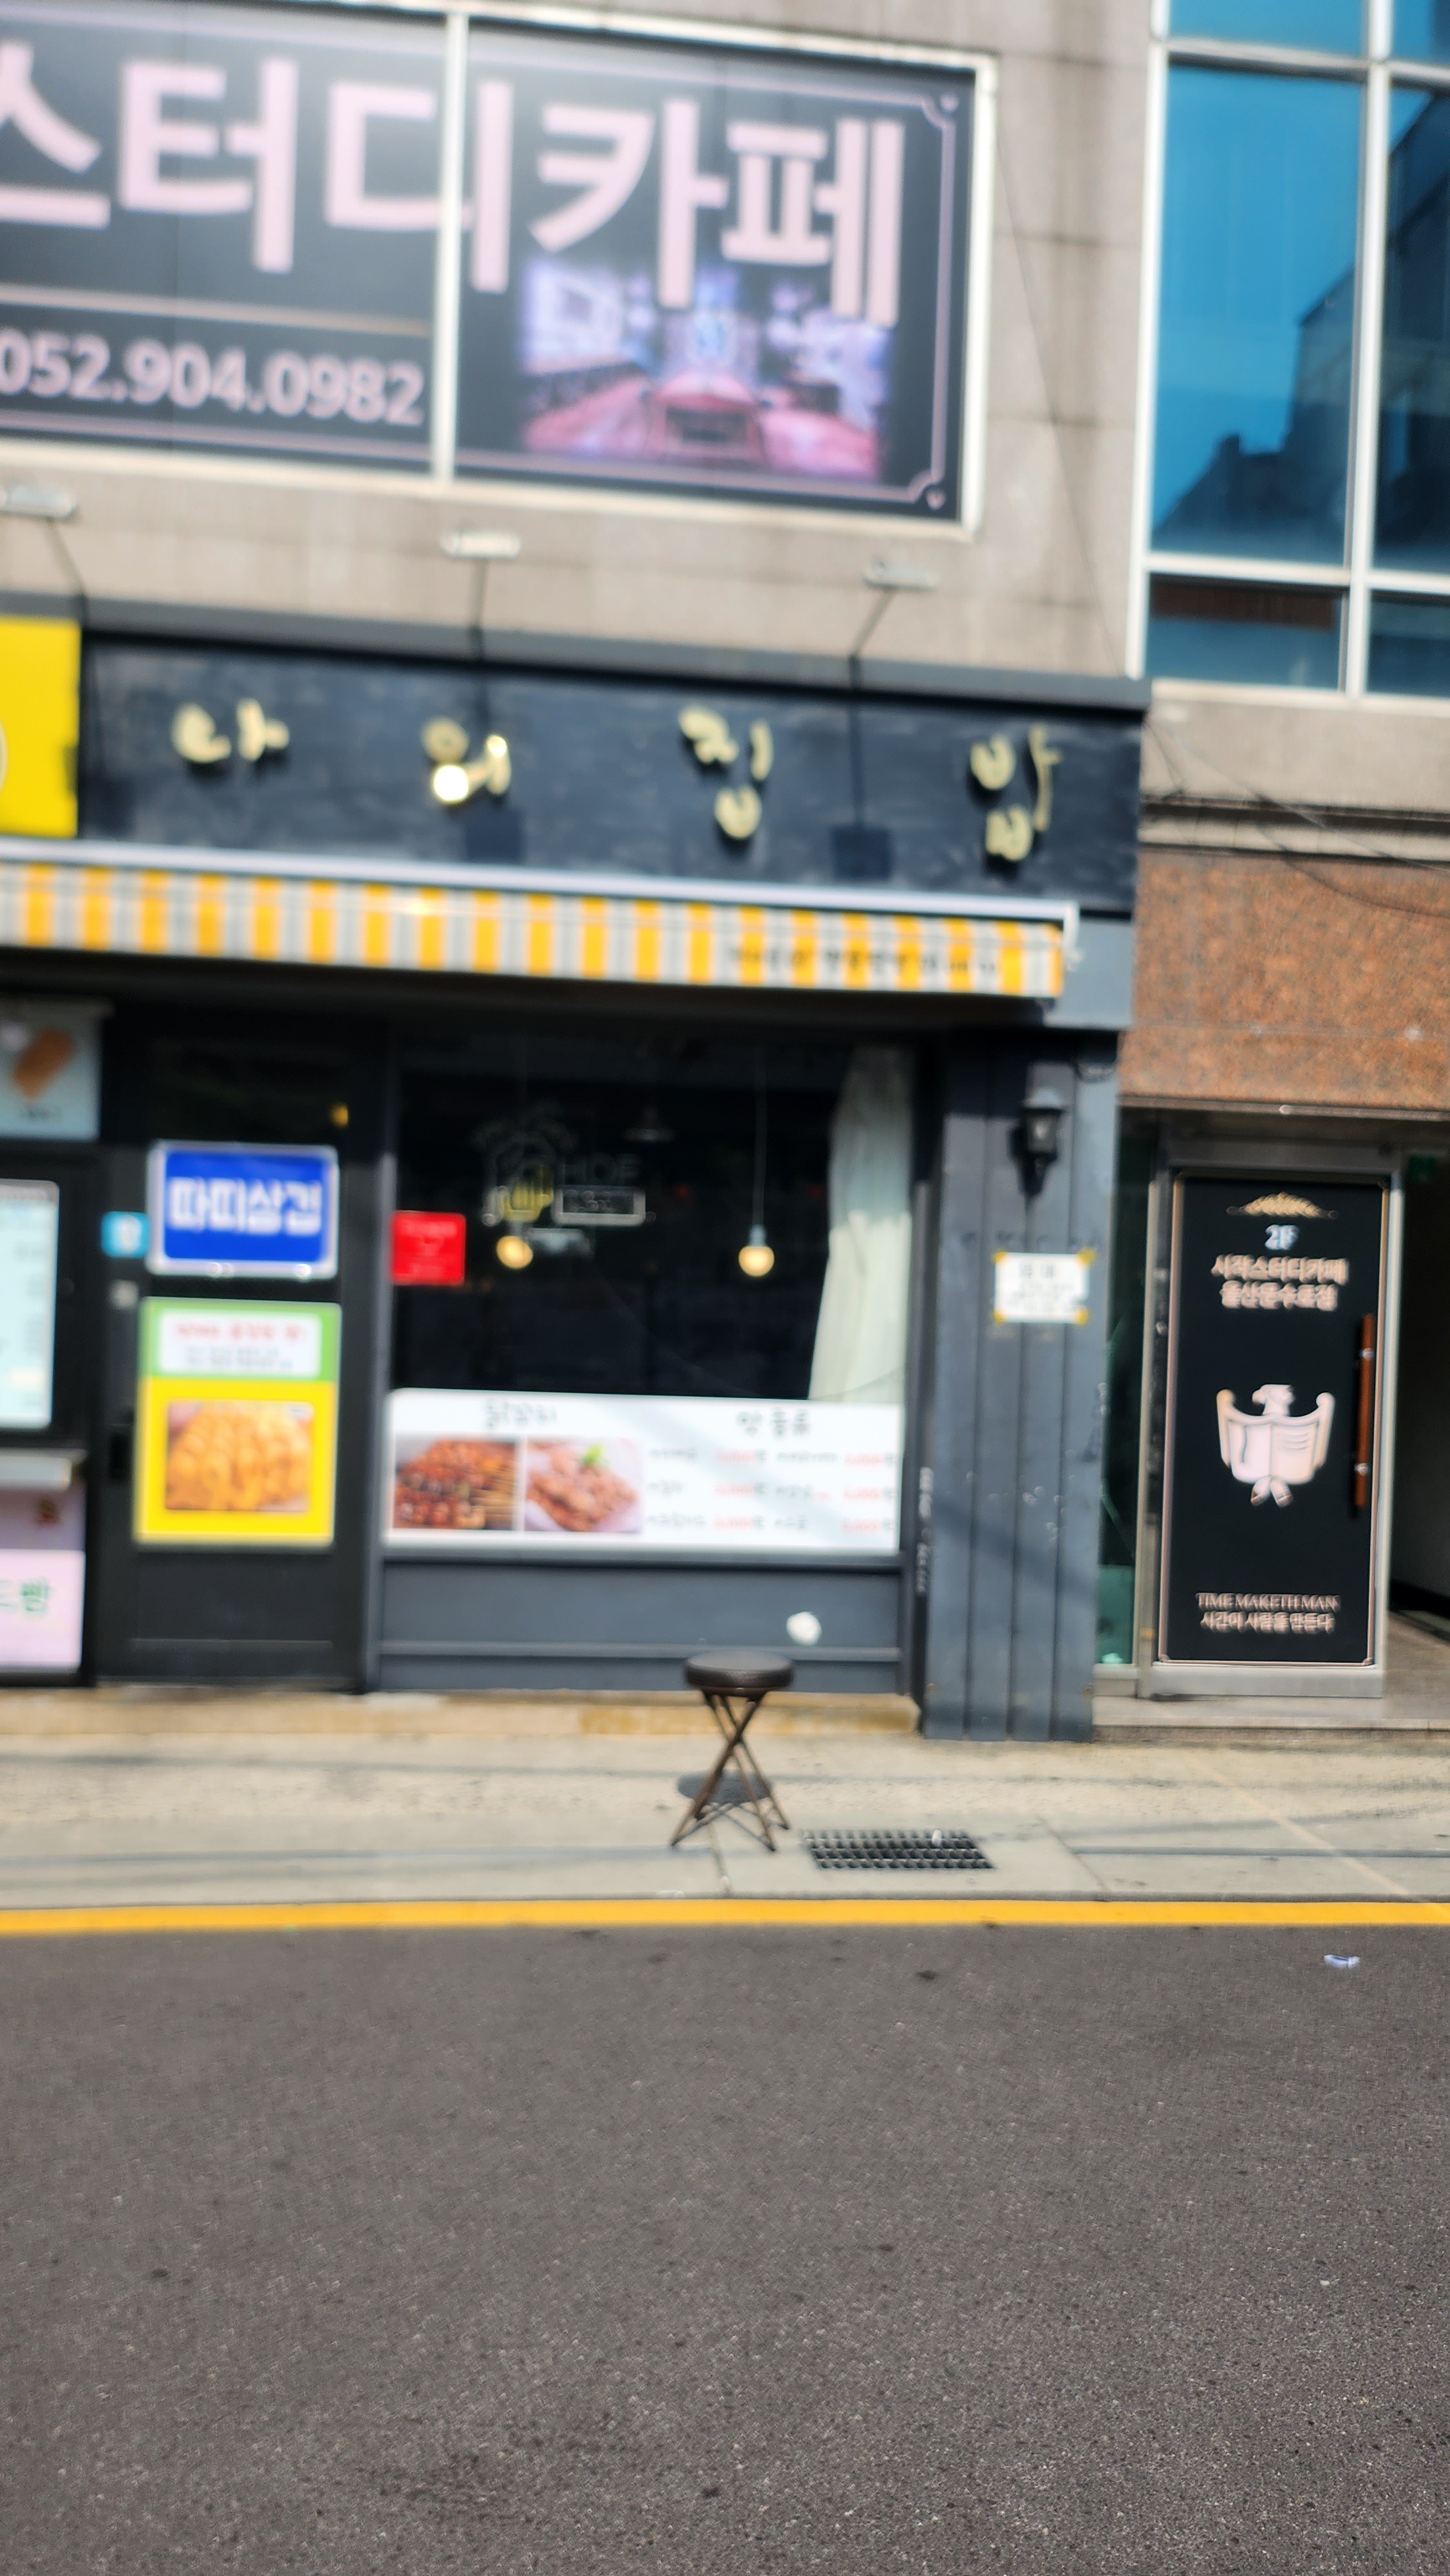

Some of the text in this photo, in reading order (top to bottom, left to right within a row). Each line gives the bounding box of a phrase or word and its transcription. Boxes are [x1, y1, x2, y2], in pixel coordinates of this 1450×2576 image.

[0, 39, 905, 327] 스터디카페
[0, 326, 426, 428] 052.904.0982
[1264, 1224, 1299, 1250] 2F
[1210, 1254, 1349, 1286] 시작스터디카페
[1196, 1593, 1341, 1612] TIME MAKETH MAN
[1200, 1611, 1335, 1634] 시간이 사람을 만든다
